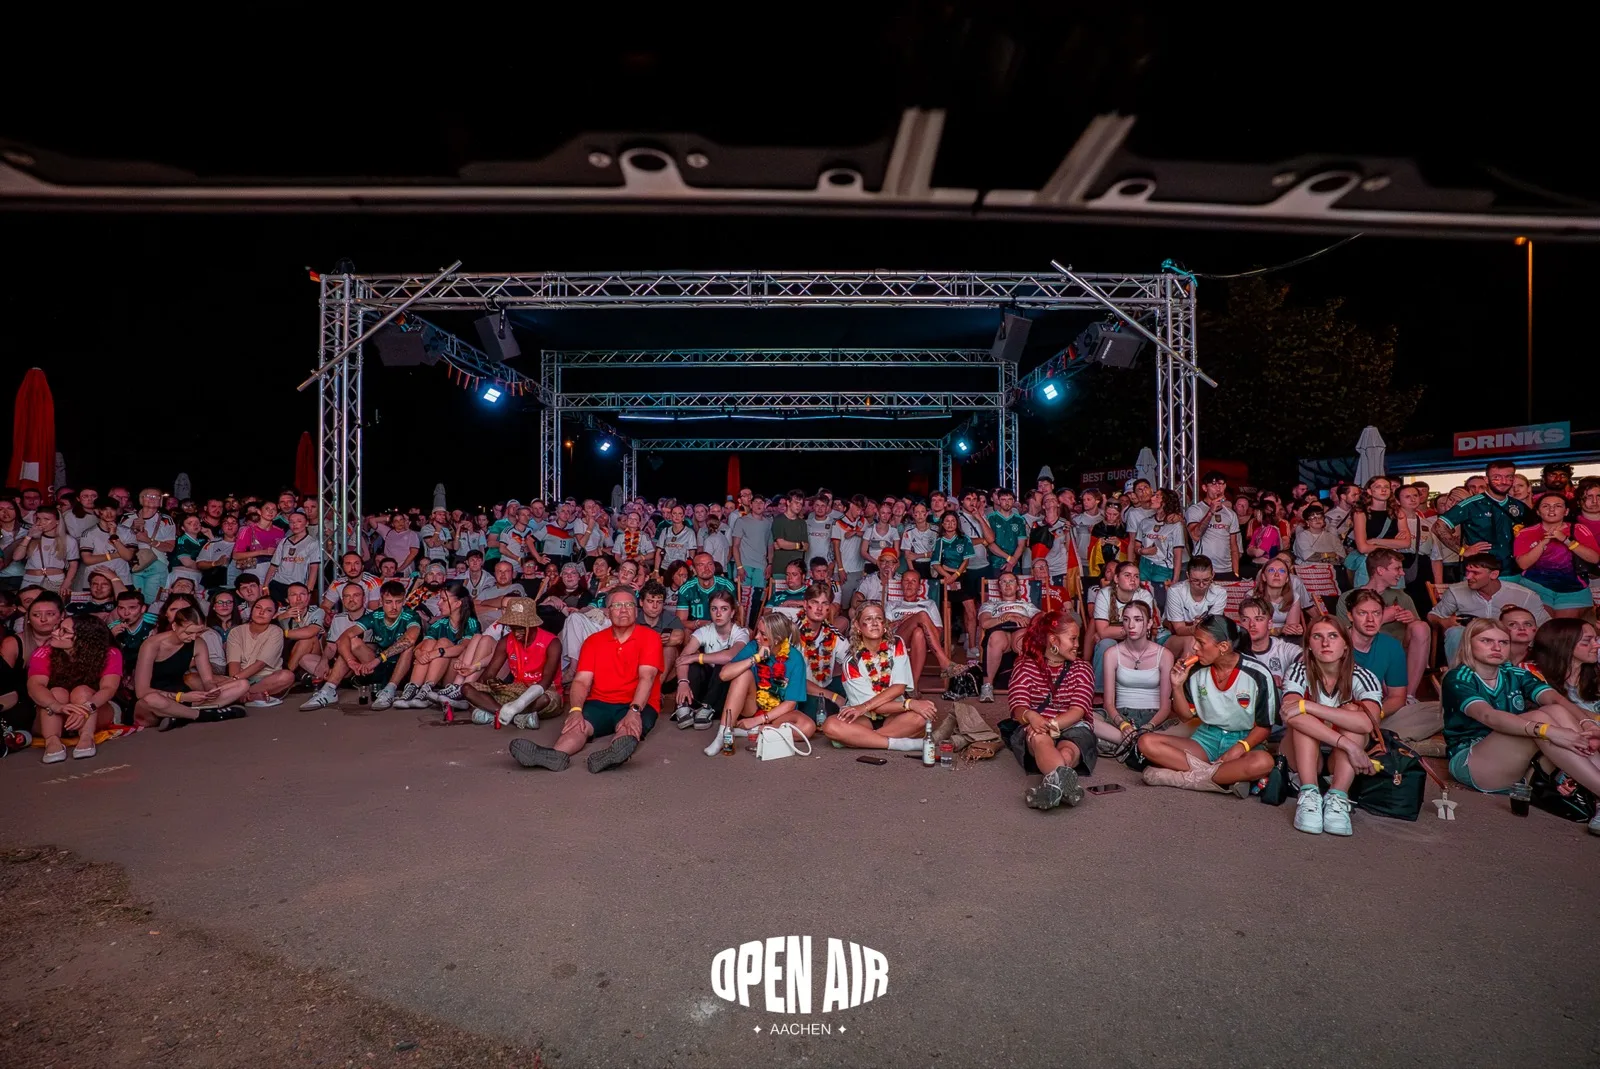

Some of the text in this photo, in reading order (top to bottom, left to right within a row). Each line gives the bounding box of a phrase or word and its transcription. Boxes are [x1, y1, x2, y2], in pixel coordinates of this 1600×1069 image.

[1458, 428, 1565, 451] DRINKS
[1082, 468, 1139, 483] BEST BURGE
